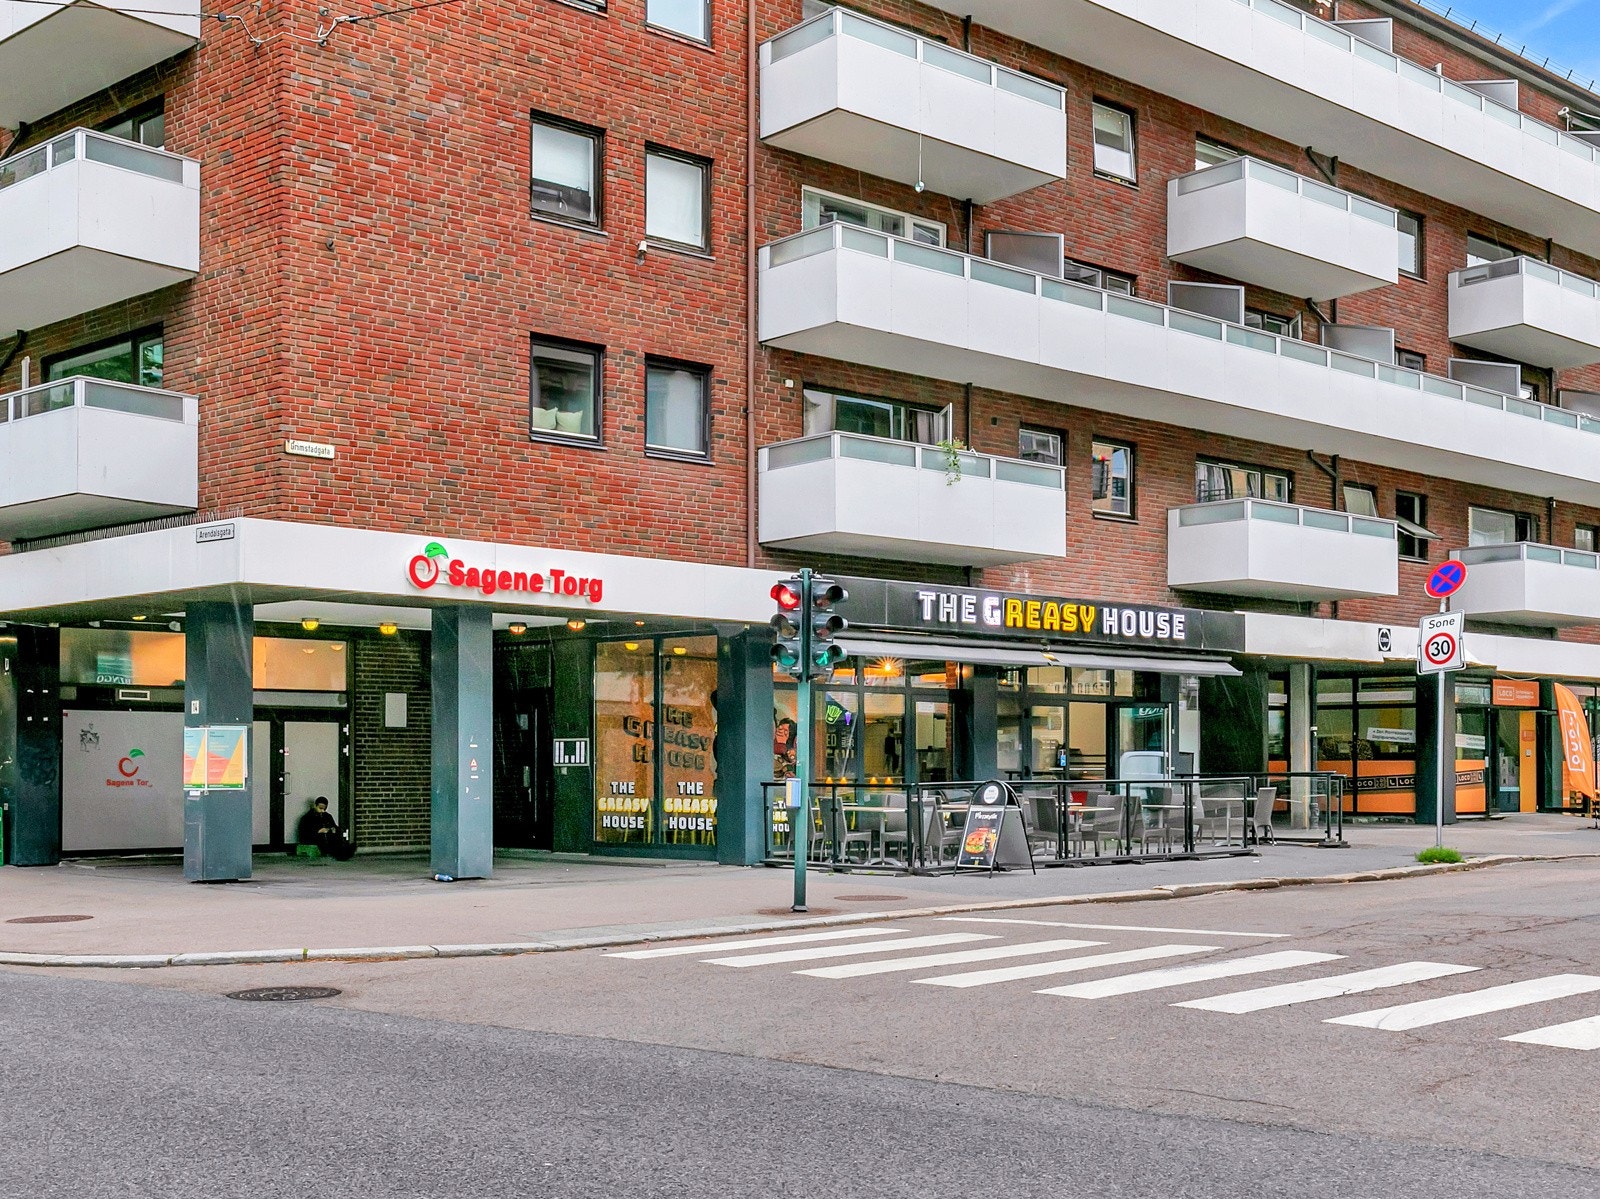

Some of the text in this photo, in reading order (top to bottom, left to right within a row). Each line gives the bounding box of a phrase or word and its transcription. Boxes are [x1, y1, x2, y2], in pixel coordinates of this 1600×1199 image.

[290, 441, 331, 455] Grimstadgata
[199, 529, 231, 539] Arendalsgata
[448, 559, 603, 603] Sagene Torg
[918, 590, 1185, 639] THE GREASY HOUSE
[1428, 618, 1456, 630] Sone
[1431, 640, 1451, 657] 30
[655, 704, 693, 728] HE
[633, 743, 705, 771] HUSE
[106, 779, 134, 787] Sagene
[611, 781, 636, 794] THE
[677, 781, 704, 795] THE
[598, 797, 650, 813] GREASY
[664, 797, 718, 814] GREASY
[602, 815, 645, 829] HOUSE
[669, 816, 713, 831] HOUSE
